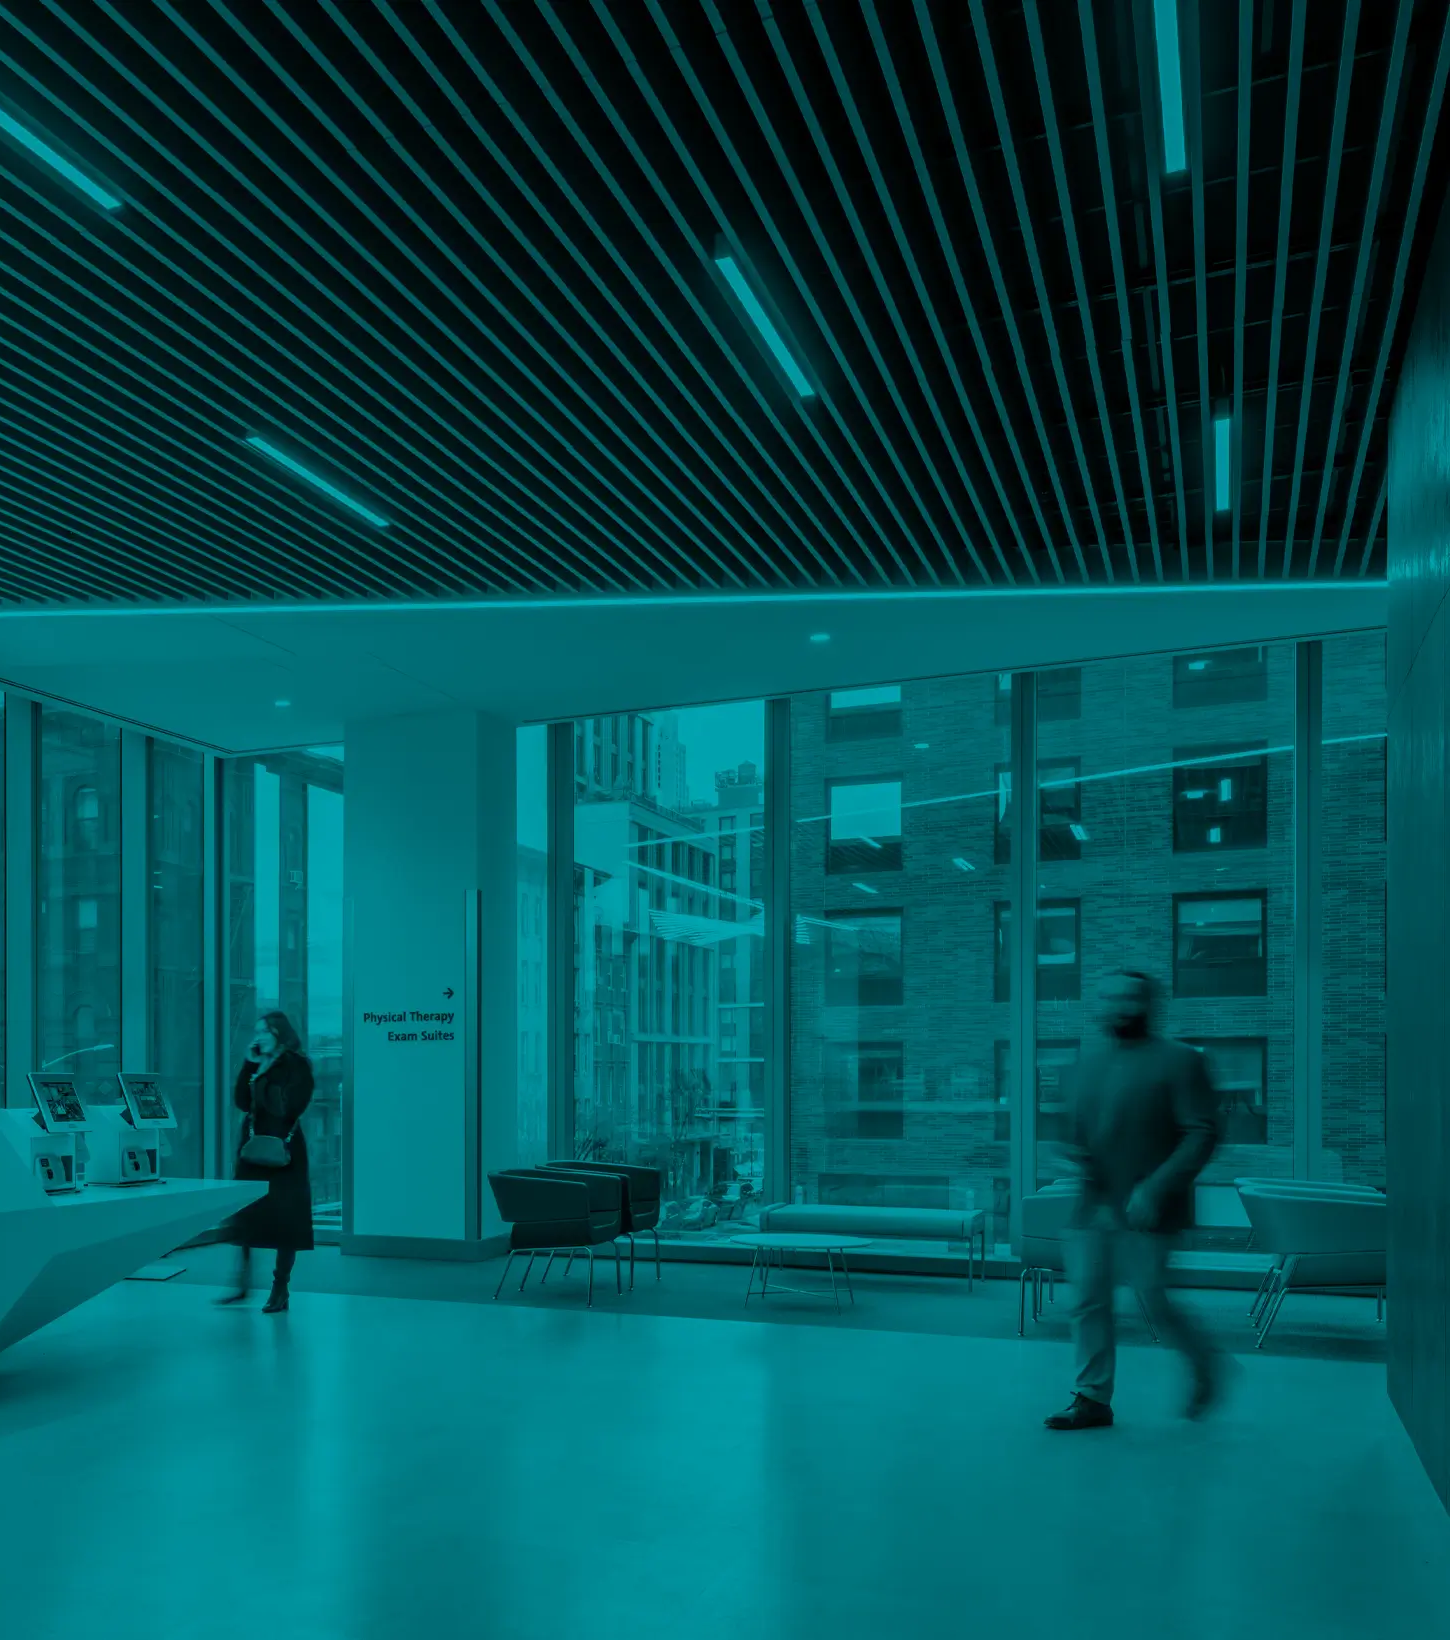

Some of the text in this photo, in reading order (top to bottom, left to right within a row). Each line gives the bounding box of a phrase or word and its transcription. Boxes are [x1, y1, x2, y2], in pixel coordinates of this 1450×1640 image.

[363, 1011, 454, 1025] Physical Therapy
[387, 1030, 454, 1042] Exam Suites
